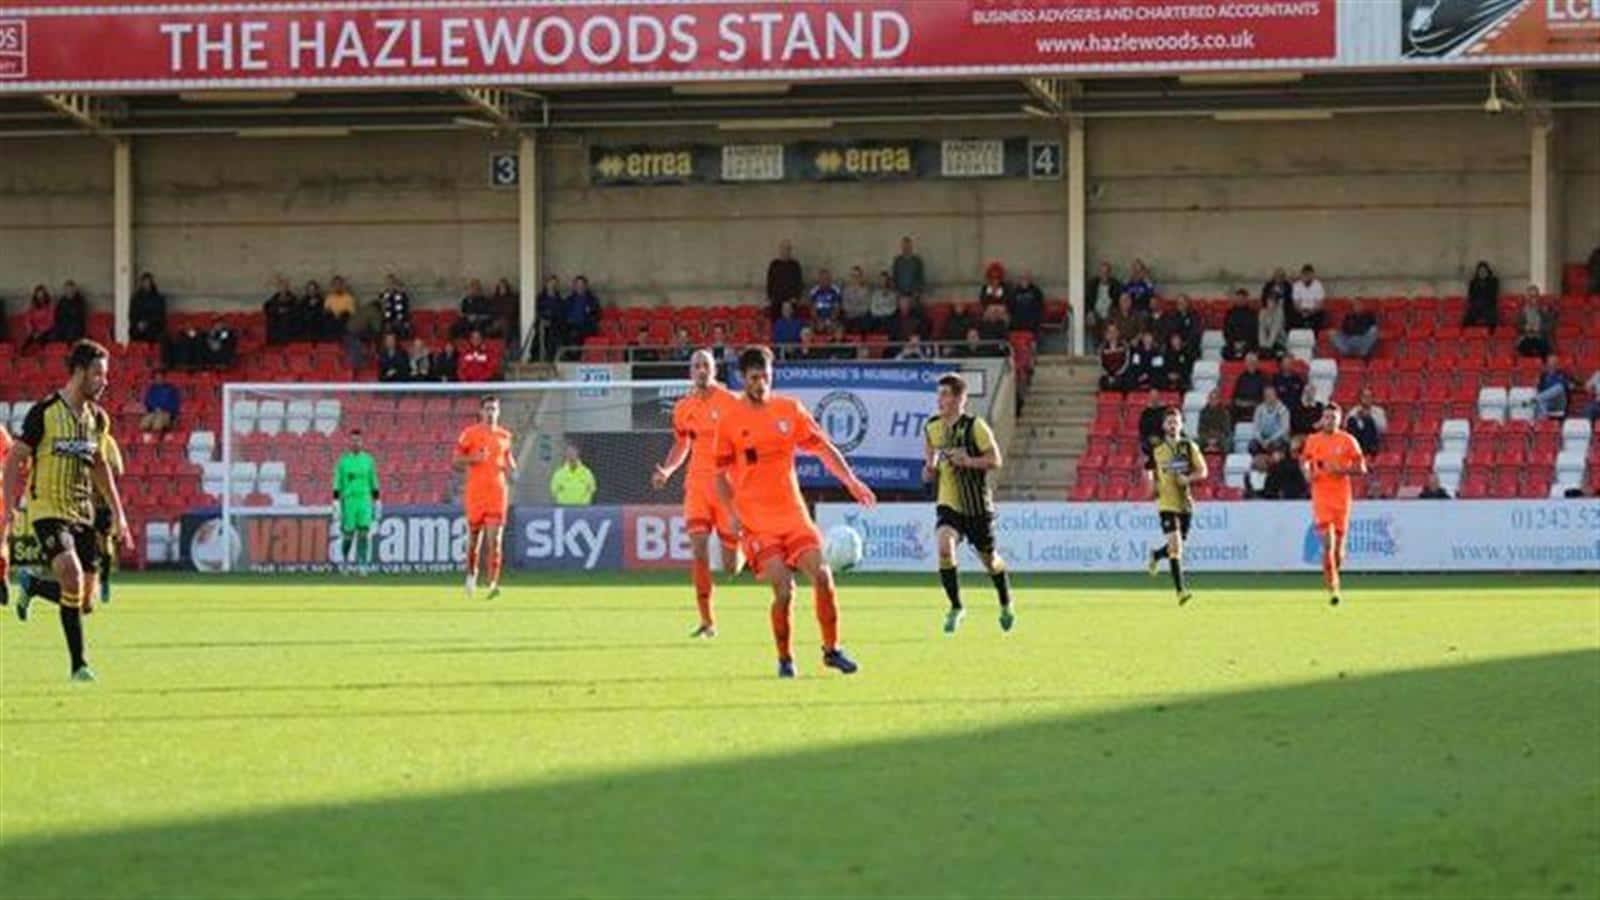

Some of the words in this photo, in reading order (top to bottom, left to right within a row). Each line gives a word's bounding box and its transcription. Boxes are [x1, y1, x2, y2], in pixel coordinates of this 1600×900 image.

[972, 10, 1035, 24] BUSINESS
[1038, 9, 1101, 22] ADVISERS
[1104, 7, 1133, 20] AND
[1135, 5, 1213, 20] CHARTERED
[1217, 2, 1320, 17] ACCOUNTANTS
[1547, 0, 1600, 20] LC
[161, 23, 268, 71] THE
[289, 14, 698, 68] HAZLEWOODS
[718, 11, 911, 61] STAND
[1036, 31, 1255, 53] www.hazlewoods.co.uk
[497, 157, 515, 183] 3
[627, 149, 692, 176] errea
[845, 146, 911, 173] errea
[1035, 146, 1055, 174] 4
[995, 509, 1090, 530] esidential
[1113, 507, 1229, 530] Comcial
[526, 506, 611, 568] sky
[636, 516, 697, 560] BE
[1127, 540, 1250, 565] Mgement
